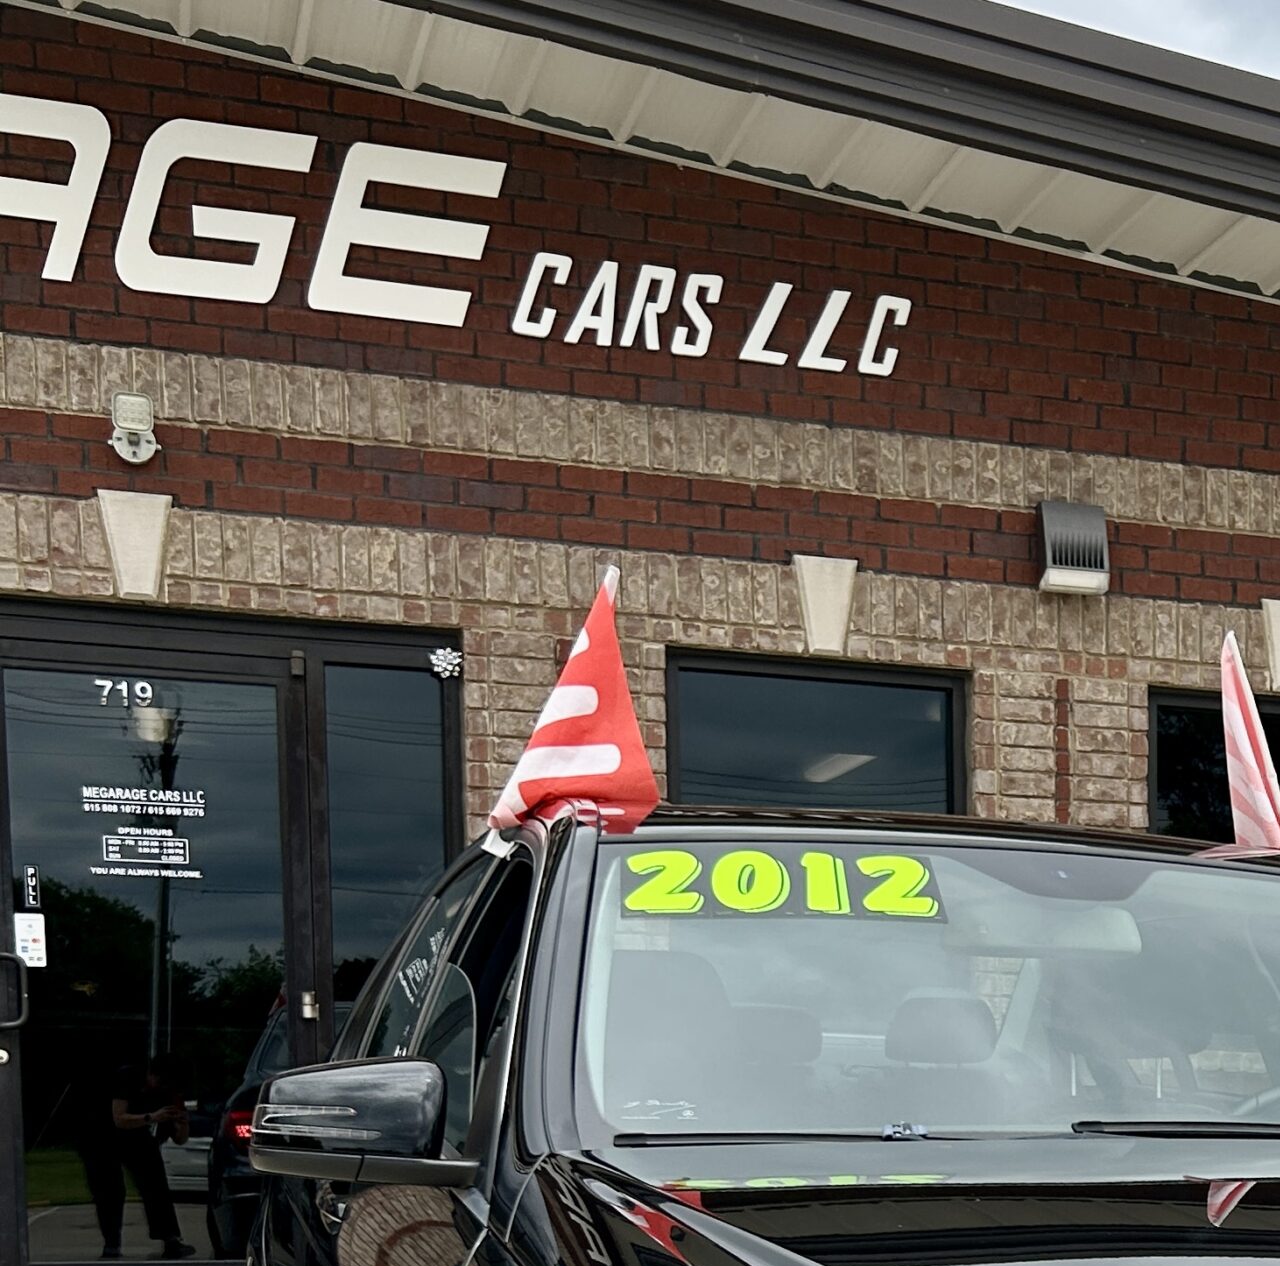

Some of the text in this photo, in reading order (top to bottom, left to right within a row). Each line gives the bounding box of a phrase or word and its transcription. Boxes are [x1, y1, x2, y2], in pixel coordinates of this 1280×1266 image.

[511, 251, 726, 358] CARS
[739, 280, 914, 378] LLC
[94, 678, 153, 707] 719
[82, 786, 205, 803] MEGARAGE CARS LLC
[83, 803, 101, 812] 615
[147, 806, 164, 815] 615
[117, 827, 173, 836] OPEN HOURS
[90, 866, 108, 875] YOU
[109, 867, 126, 875] ARE
[126, 868, 159, 876] ALWAYS
[27, 867, 37, 905] PULL
[623, 849, 940, 918] 2012
